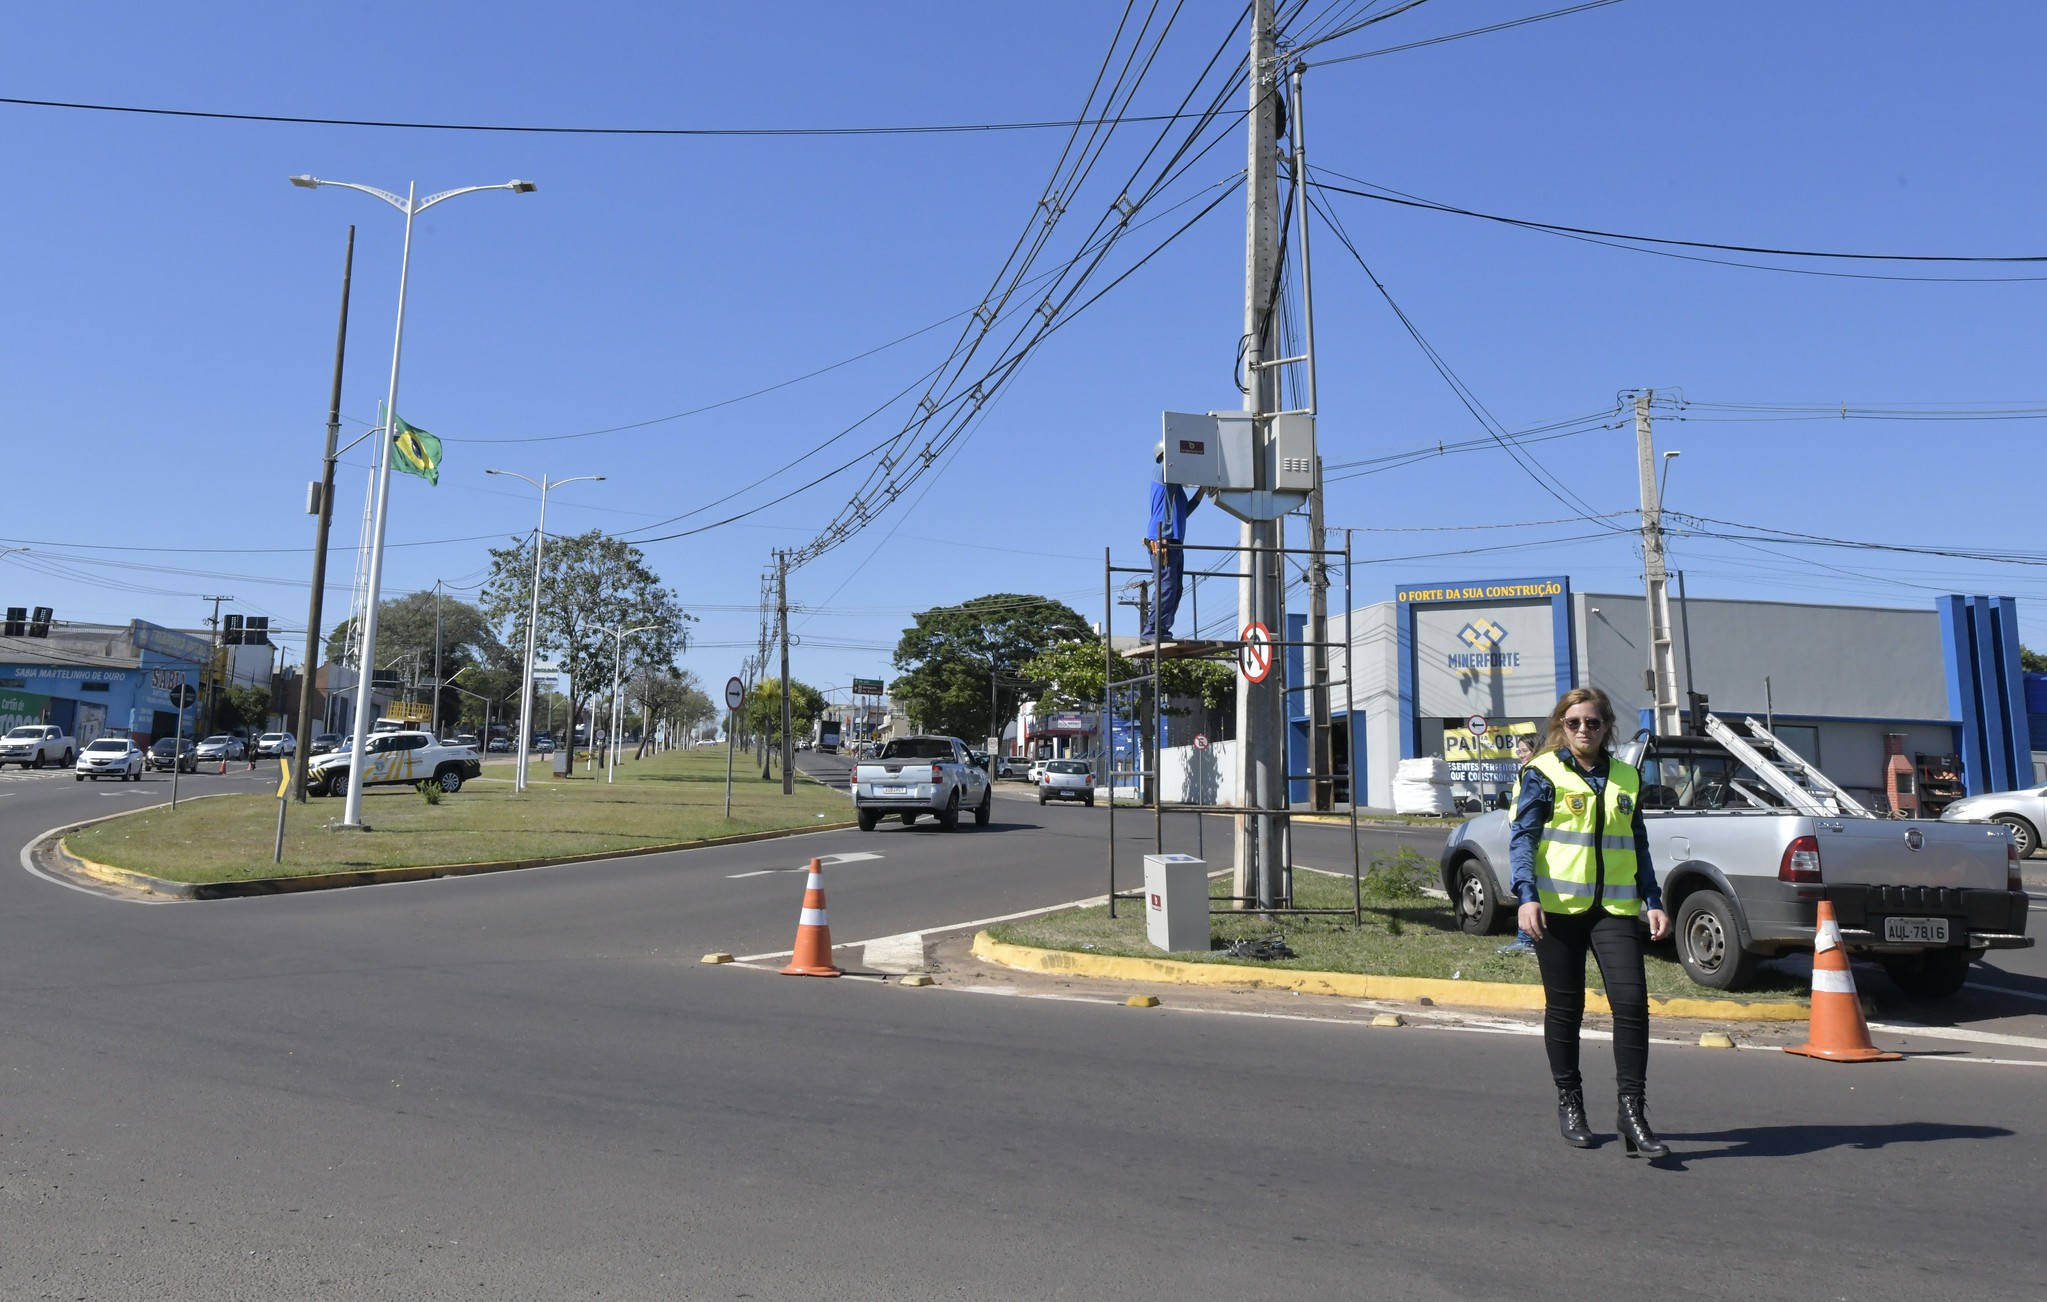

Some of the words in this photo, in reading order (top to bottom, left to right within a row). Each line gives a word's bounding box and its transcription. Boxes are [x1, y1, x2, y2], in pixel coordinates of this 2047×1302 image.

[1399, 591, 1406, 601] O
[1409, 589, 1443, 601] FORTE
[1446, 588, 1461, 599] DA
[1463, 587, 1484, 598] SUA
[1486, 581, 1561, 597] CONSTRUÇÃO
[1448, 652, 1520, 668] MINERFORTE
[40, 669, 90, 680] MARTELINHO
[91, 671, 102, 680] DE
[103, 672, 125, 681] OURO
[1446, 736, 1477, 752] PAI
[1450, 772, 1465, 781] QUE
